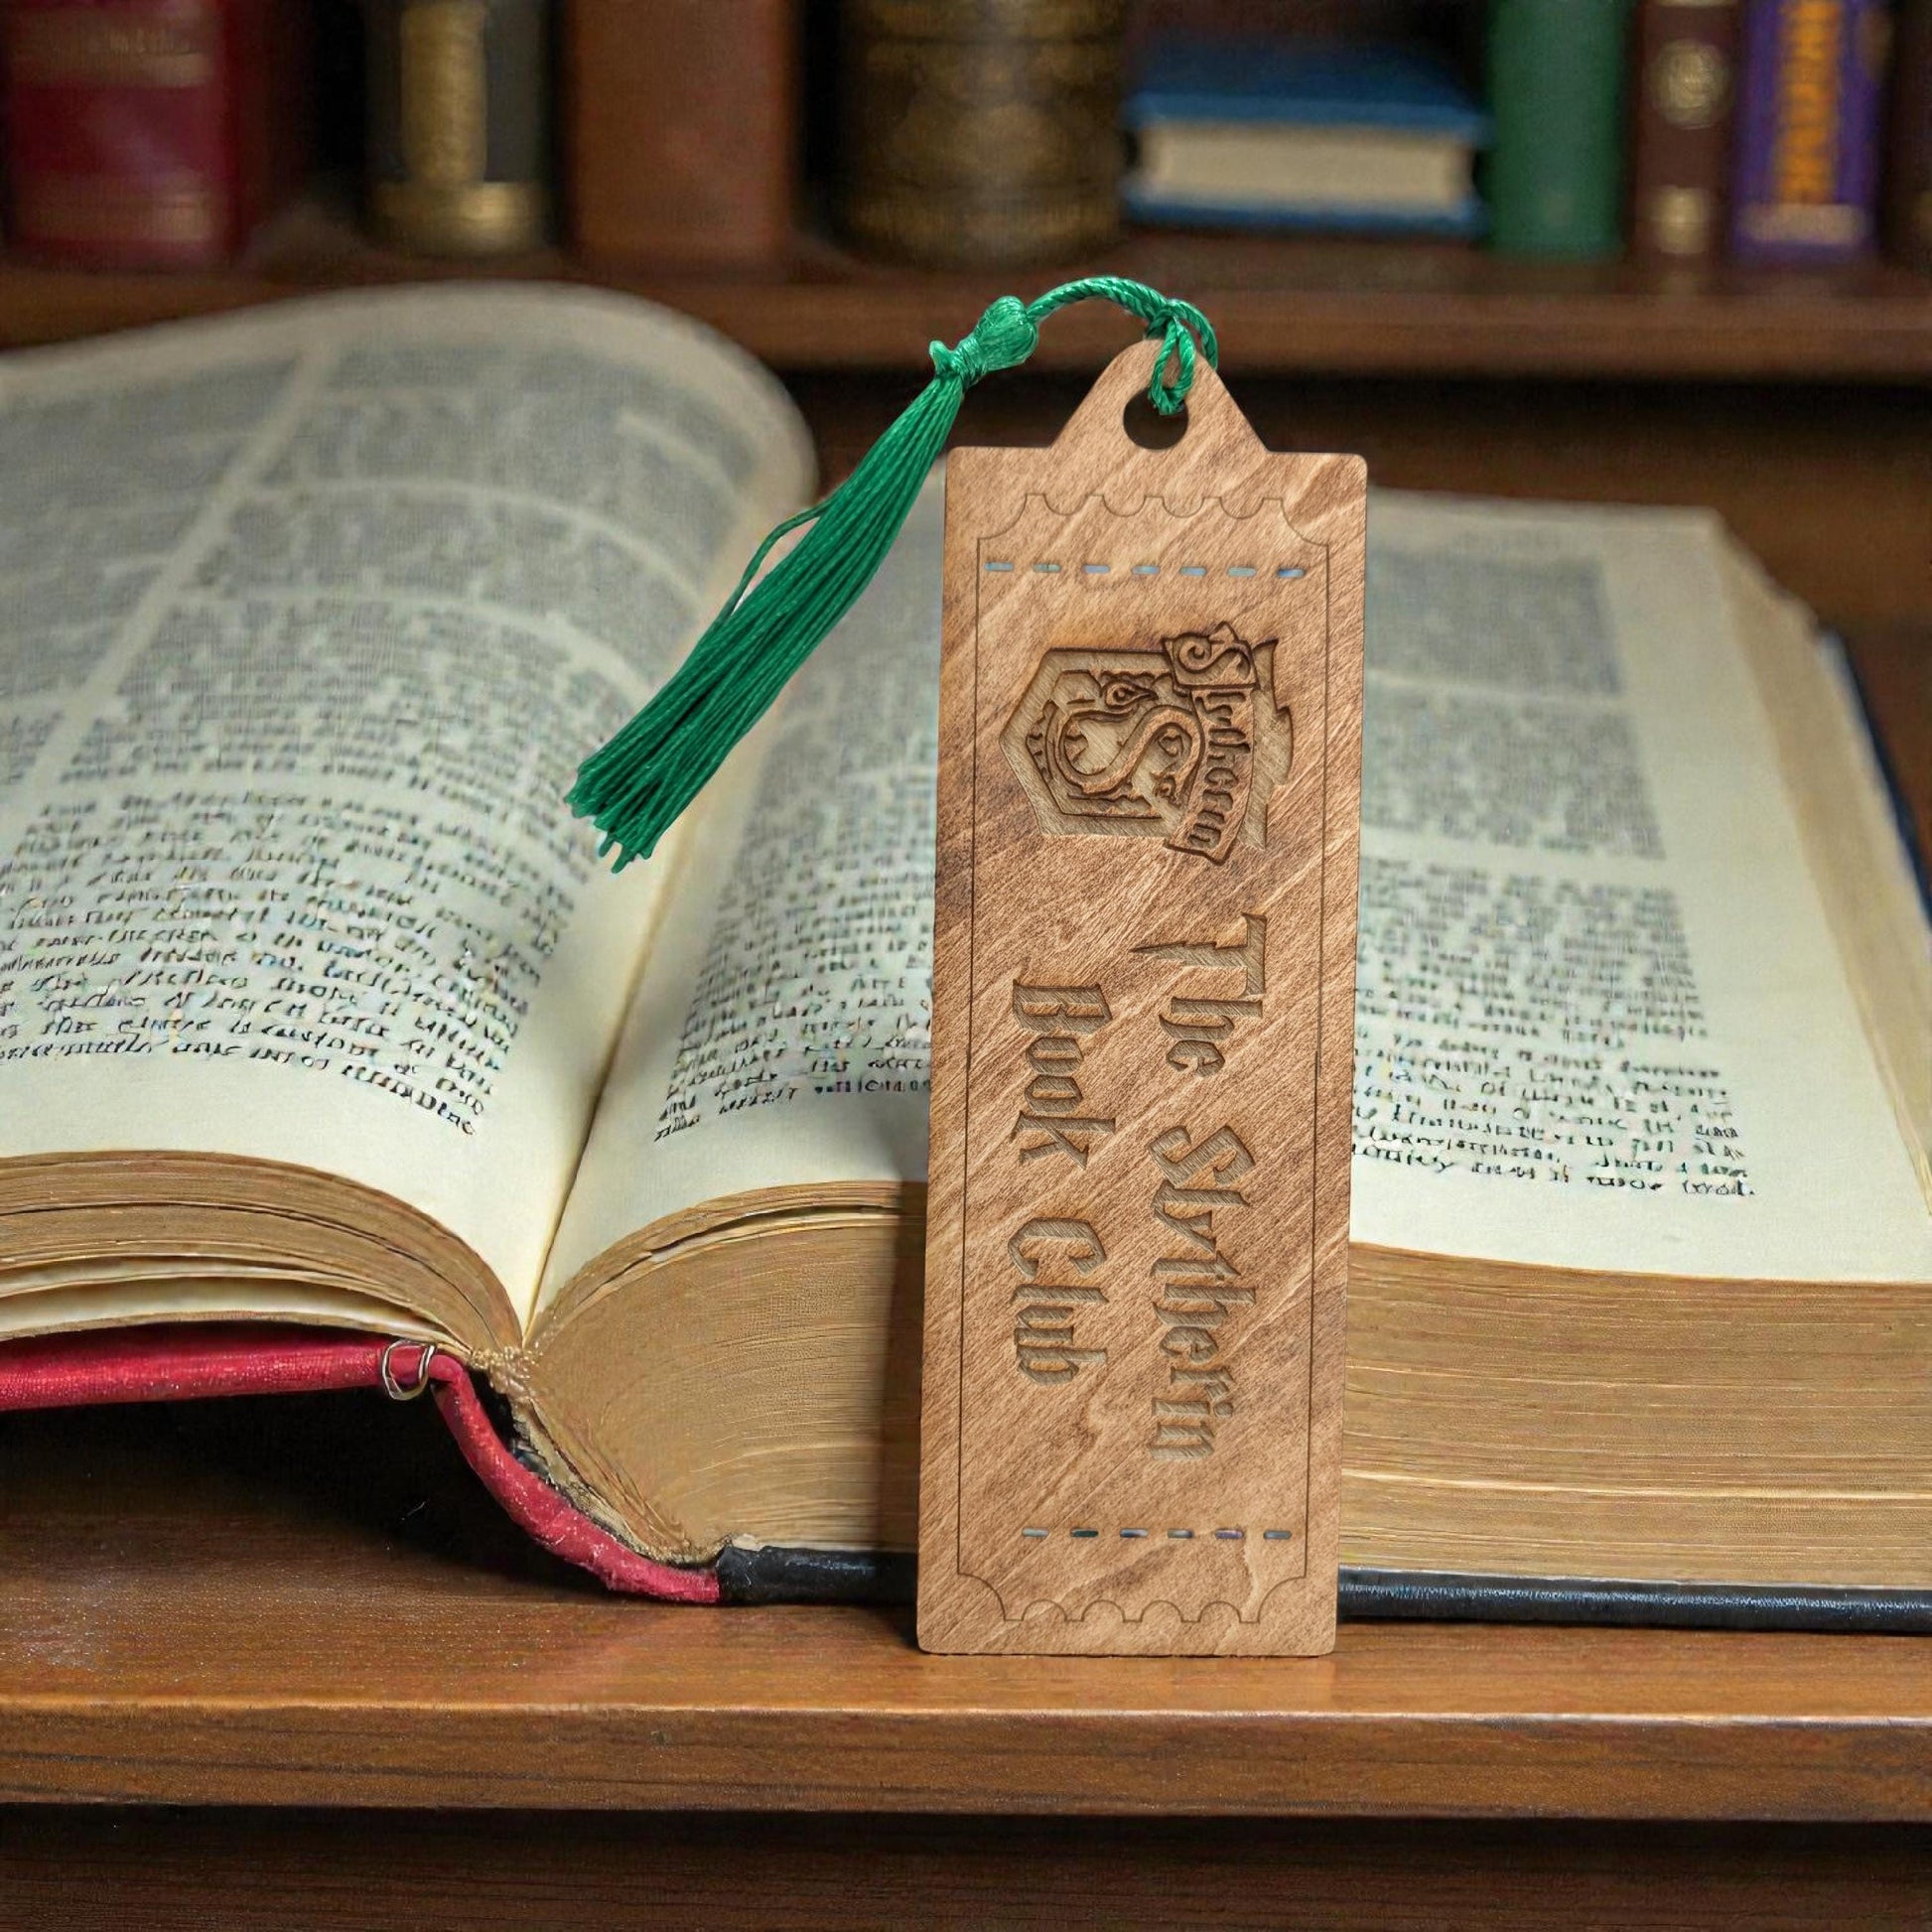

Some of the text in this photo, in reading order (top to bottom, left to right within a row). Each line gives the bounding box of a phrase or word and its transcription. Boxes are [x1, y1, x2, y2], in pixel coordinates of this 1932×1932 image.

[1173, 632, 1253, 849] Slytherin
[1007, 978, 1117, 1386] Book Club
[1130, 912, 1268, 1461] The Slytherin
